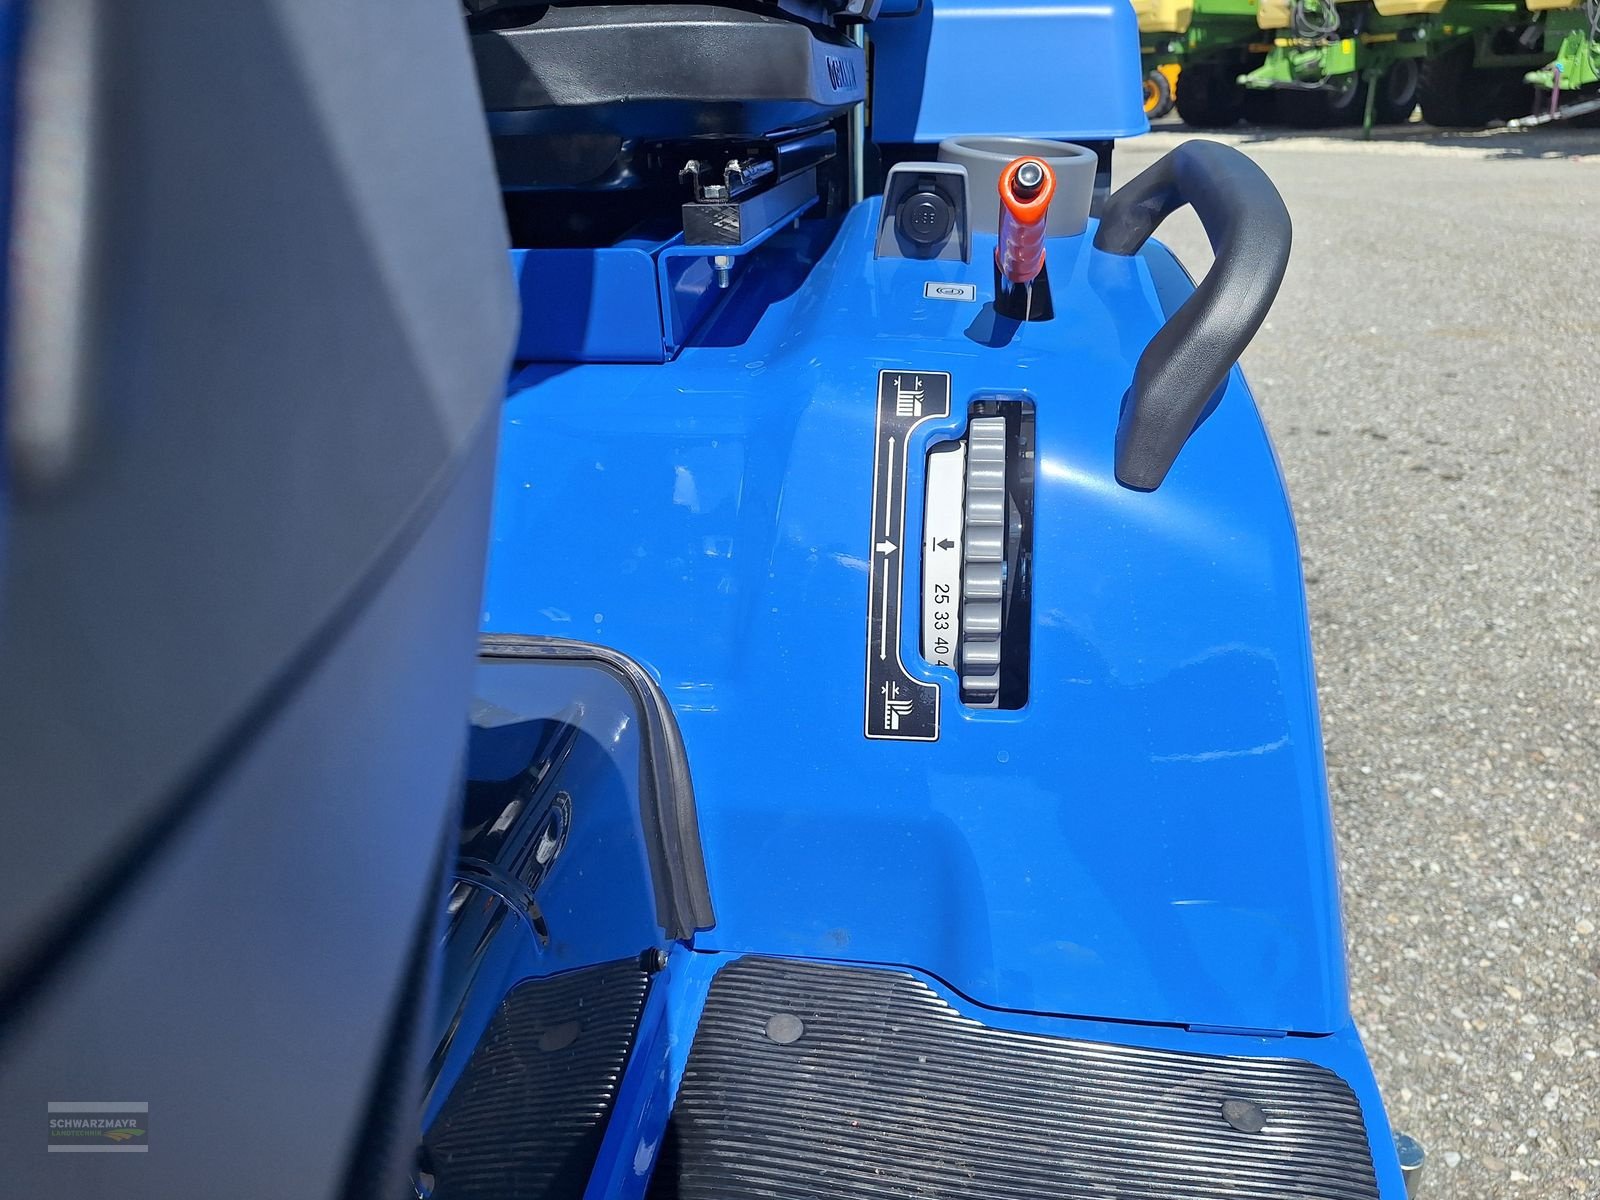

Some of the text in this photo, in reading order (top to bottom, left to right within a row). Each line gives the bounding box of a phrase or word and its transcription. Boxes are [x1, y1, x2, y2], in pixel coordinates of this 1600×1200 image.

[934, 583, 950, 604] 25
[934, 611, 950, 630] 33
[934, 636, 949, 654] 40
